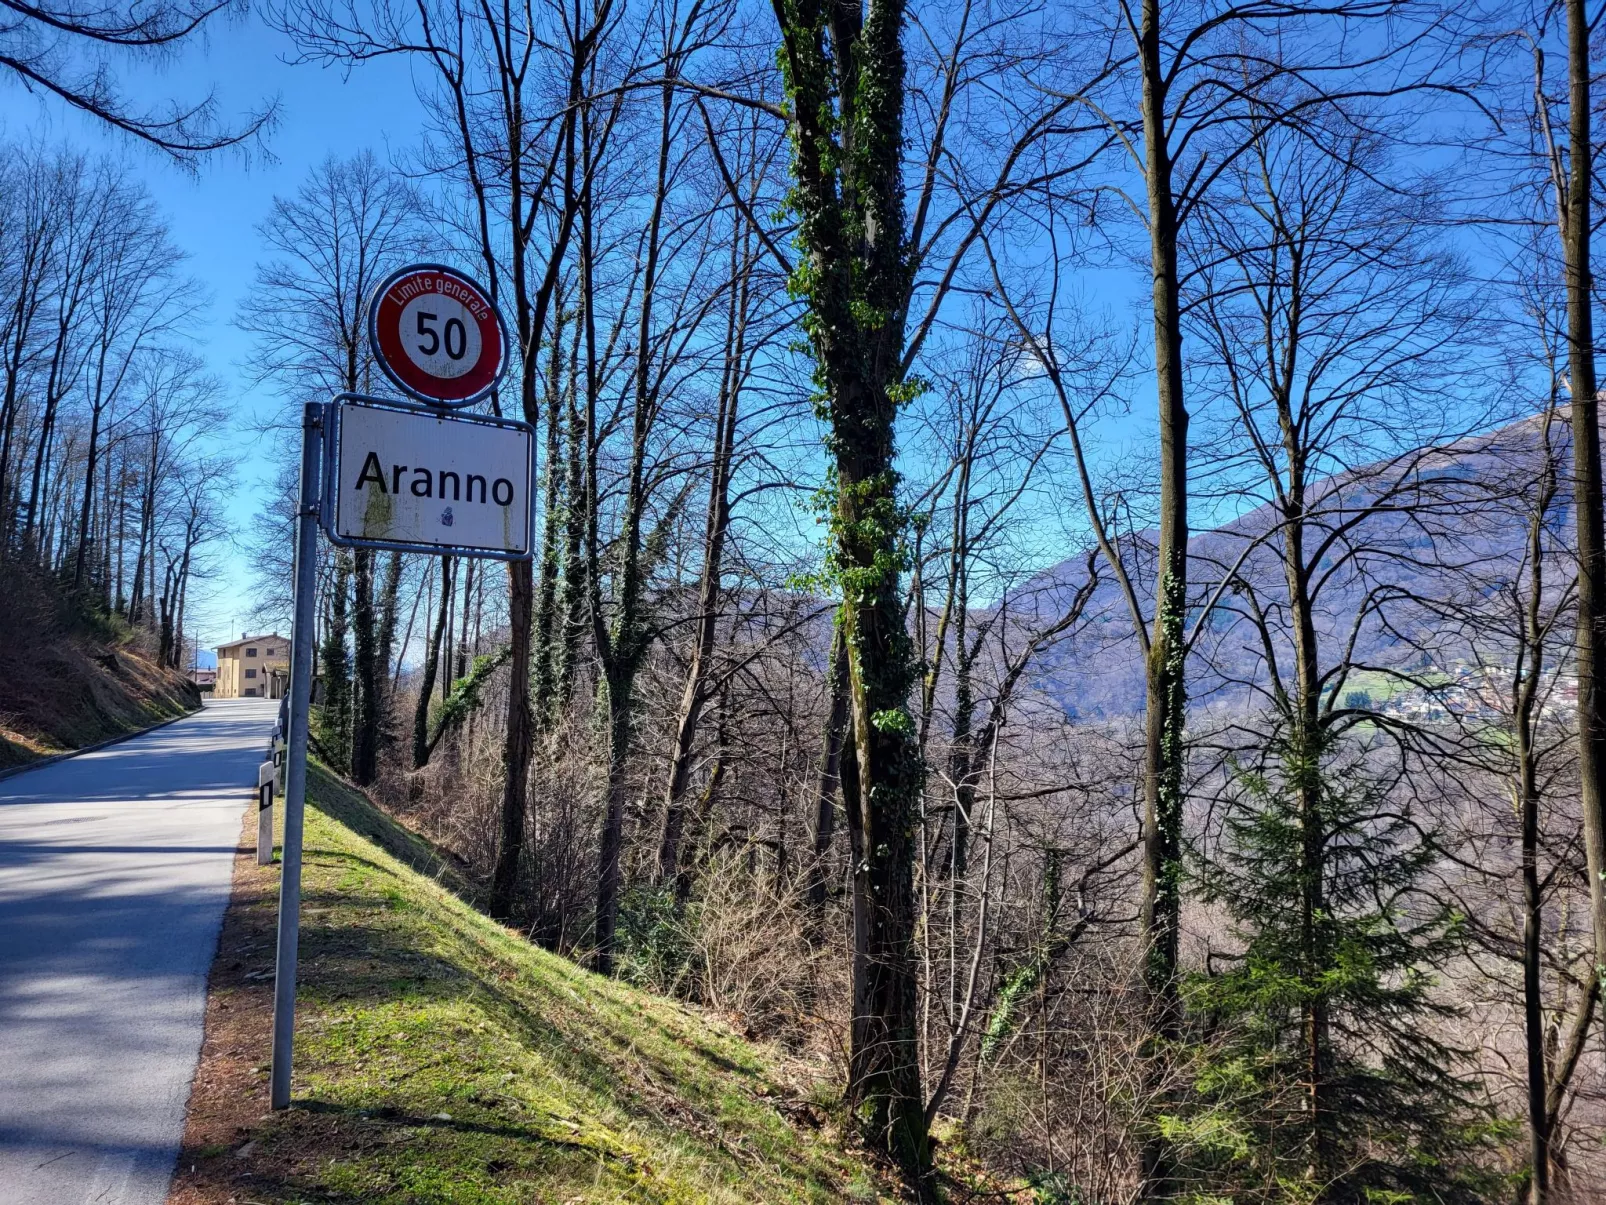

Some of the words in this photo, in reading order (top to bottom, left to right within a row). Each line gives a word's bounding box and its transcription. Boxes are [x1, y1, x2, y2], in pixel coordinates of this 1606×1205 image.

[388, 277, 432, 306] Limite
[436, 279, 488, 321] generale
[417, 311, 467, 360] 50
[355, 451, 514, 507] Aranno
